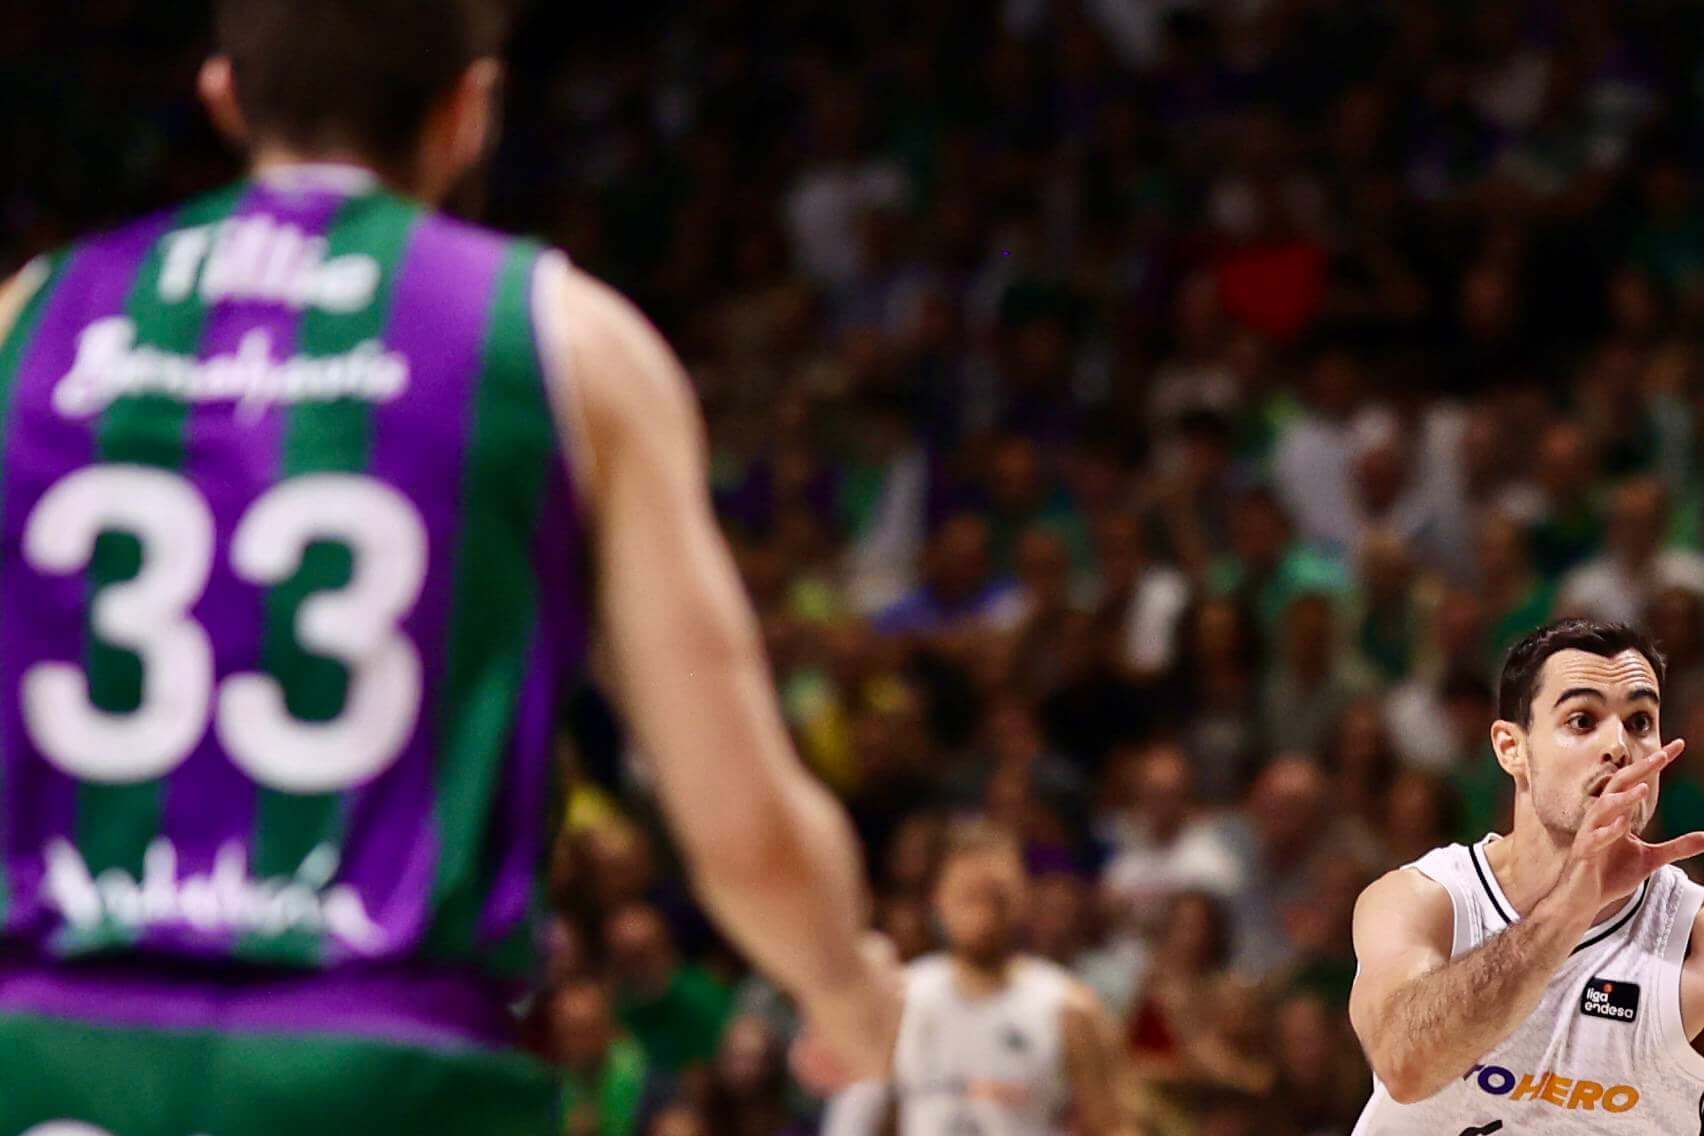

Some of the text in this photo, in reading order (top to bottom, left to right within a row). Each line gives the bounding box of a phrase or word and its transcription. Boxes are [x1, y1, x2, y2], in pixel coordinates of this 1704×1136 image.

[20, 462, 431, 796] 33
[1584, 1001, 1634, 1019] endesa
[1586, 987, 1608, 1003] liga
[1463, 1063, 1641, 1113] OHERO
